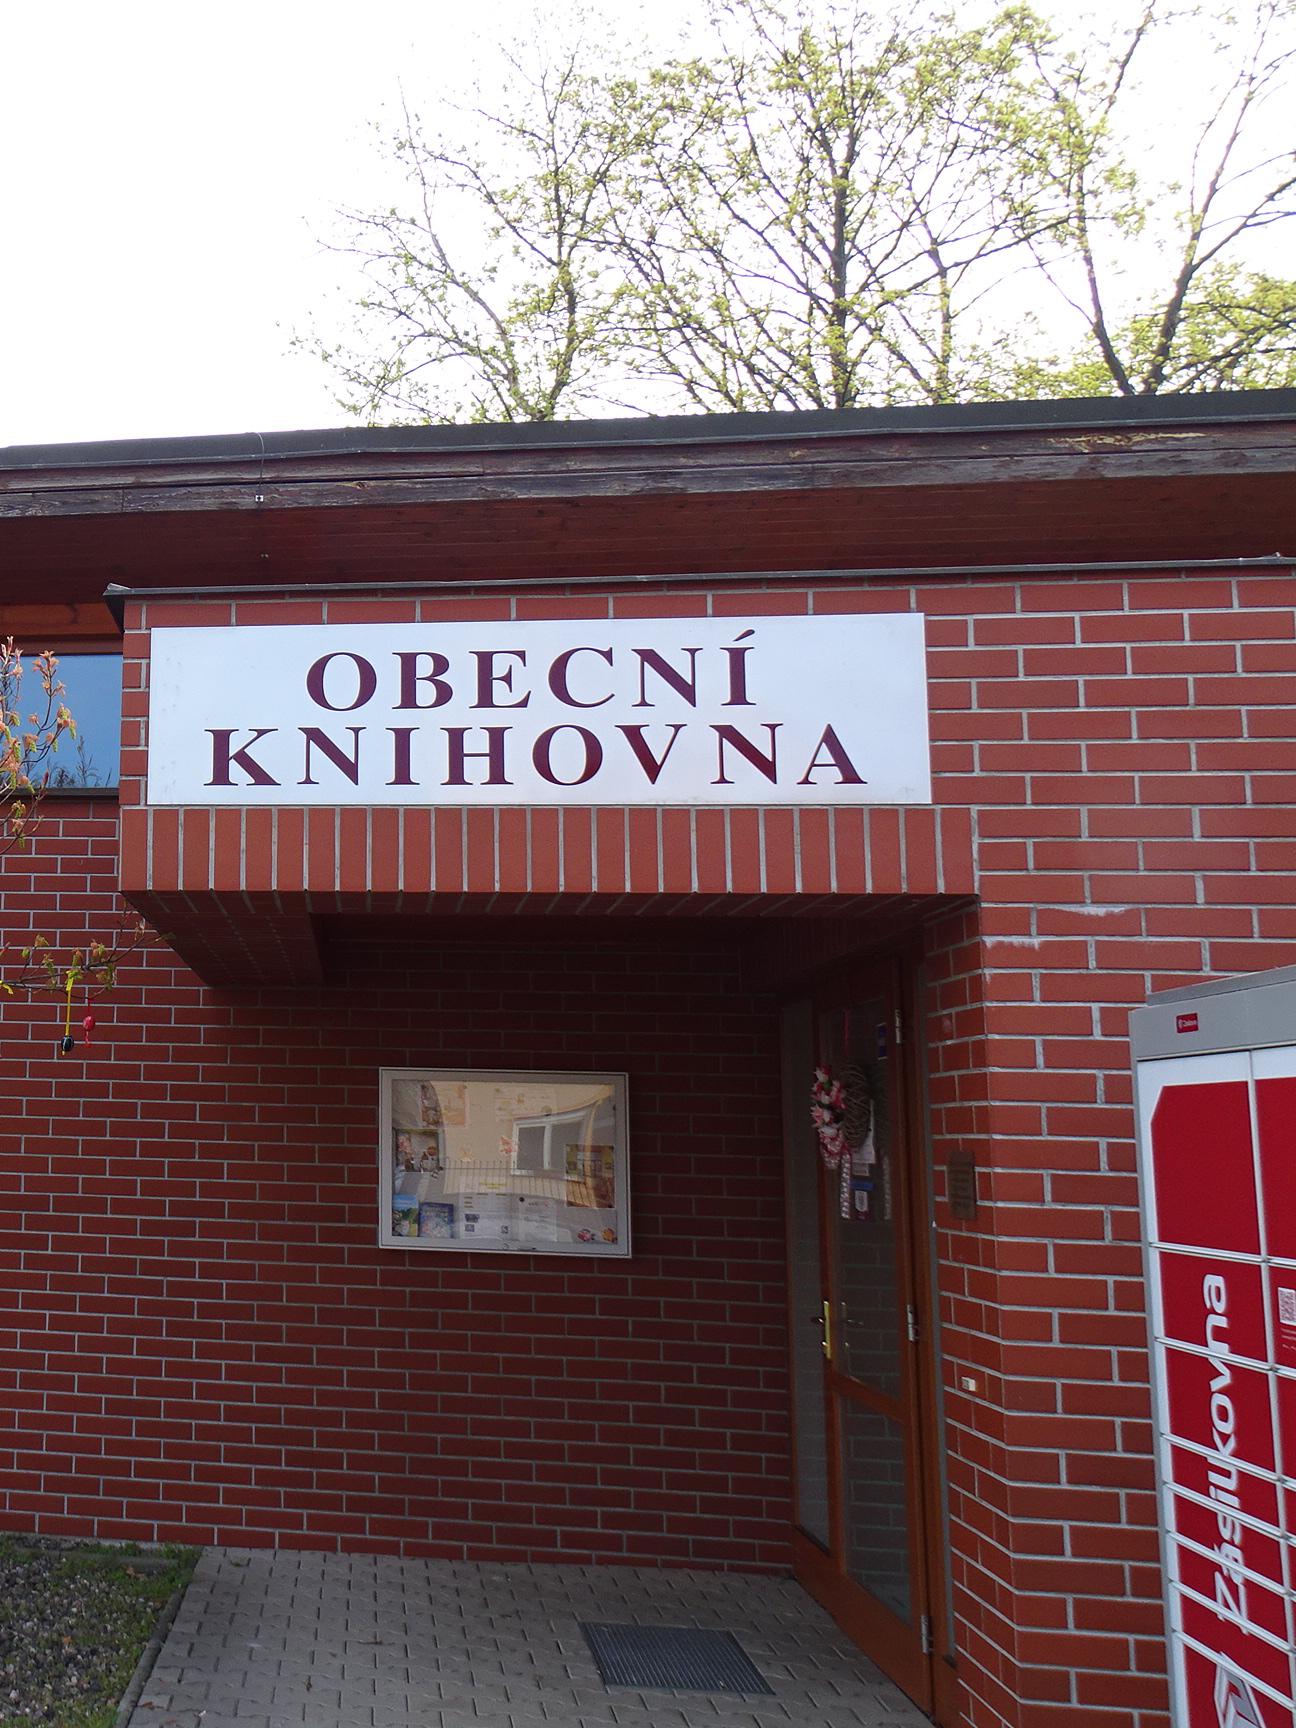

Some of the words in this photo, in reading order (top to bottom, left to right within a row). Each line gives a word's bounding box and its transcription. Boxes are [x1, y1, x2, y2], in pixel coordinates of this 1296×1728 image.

[306, 629, 757, 711] OBECNÍ
[203, 723, 868, 787] KNIHOVNA
[1203, 1273, 1249, 1636] Zásilkovna
